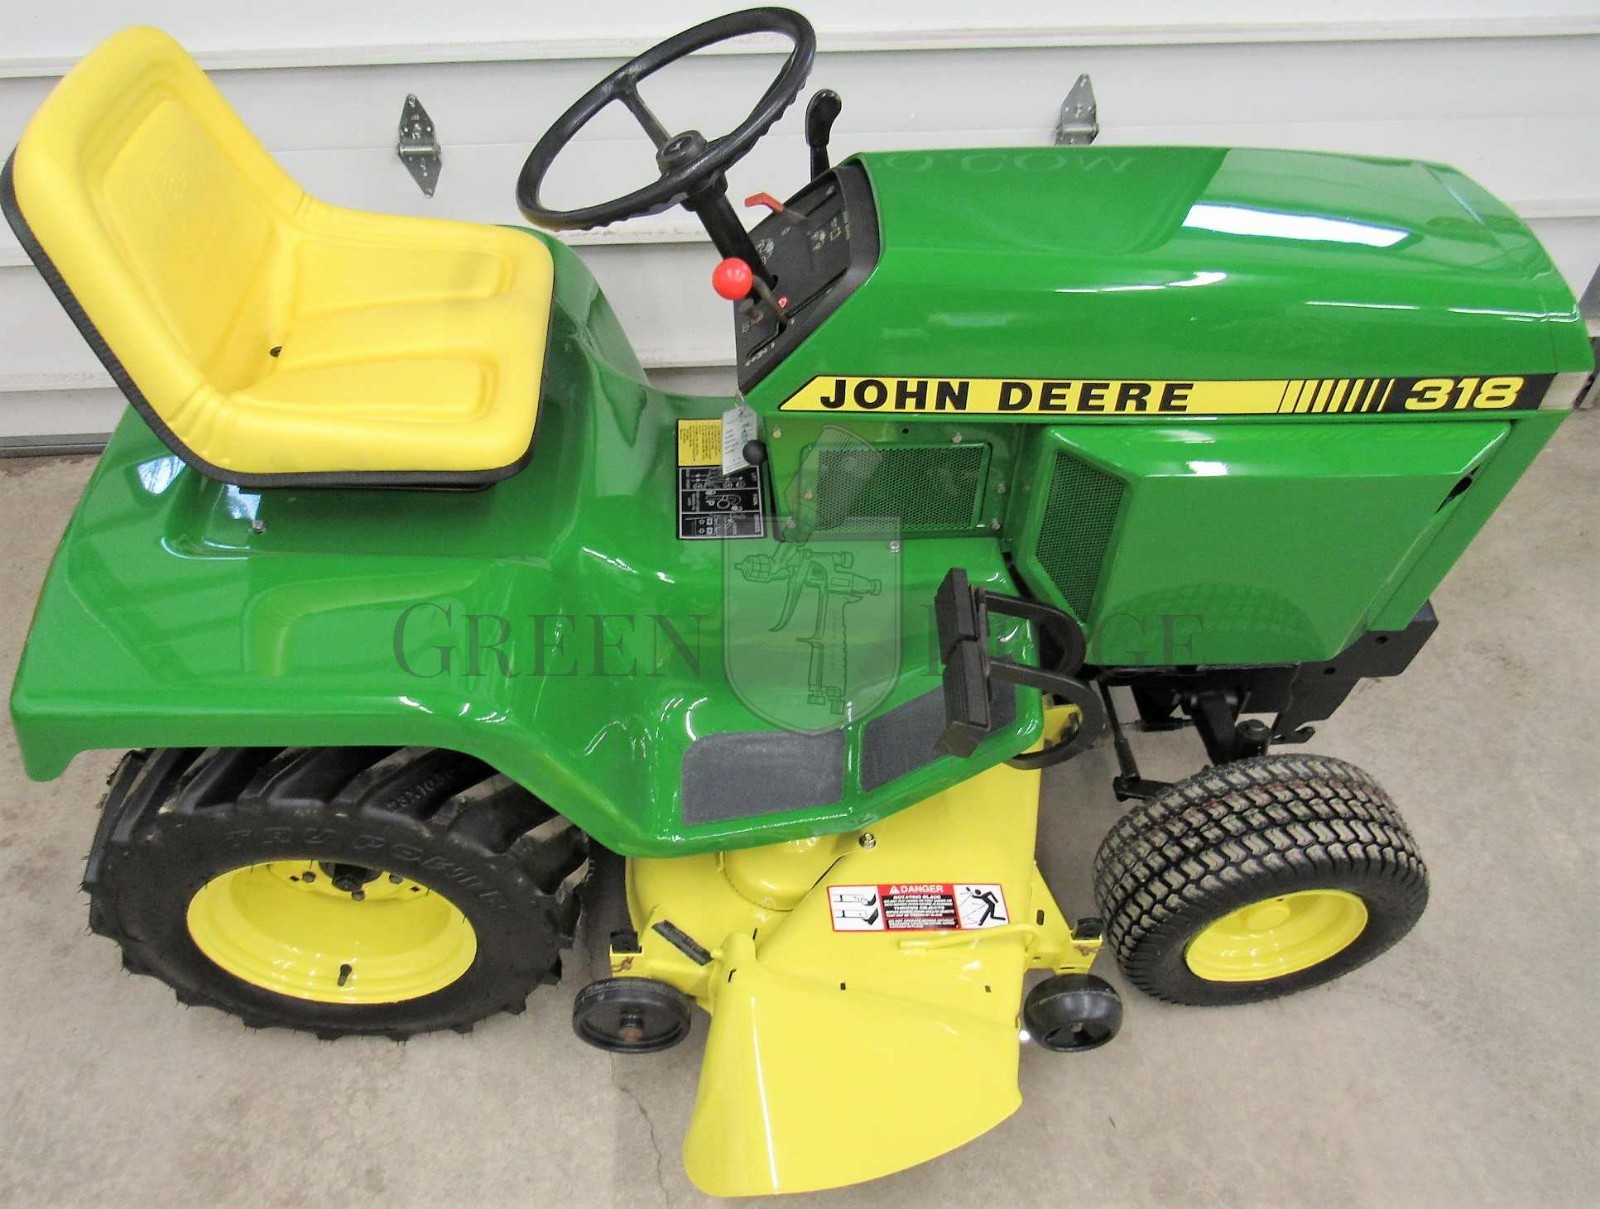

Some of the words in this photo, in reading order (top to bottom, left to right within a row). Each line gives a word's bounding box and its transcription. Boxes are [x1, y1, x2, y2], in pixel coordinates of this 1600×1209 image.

[820, 379, 970, 410] JOHN
[998, 382, 1194, 412] DEERE
[1404, 376, 1524, 411] 318
[901, 885, 944, 893] DANGER
